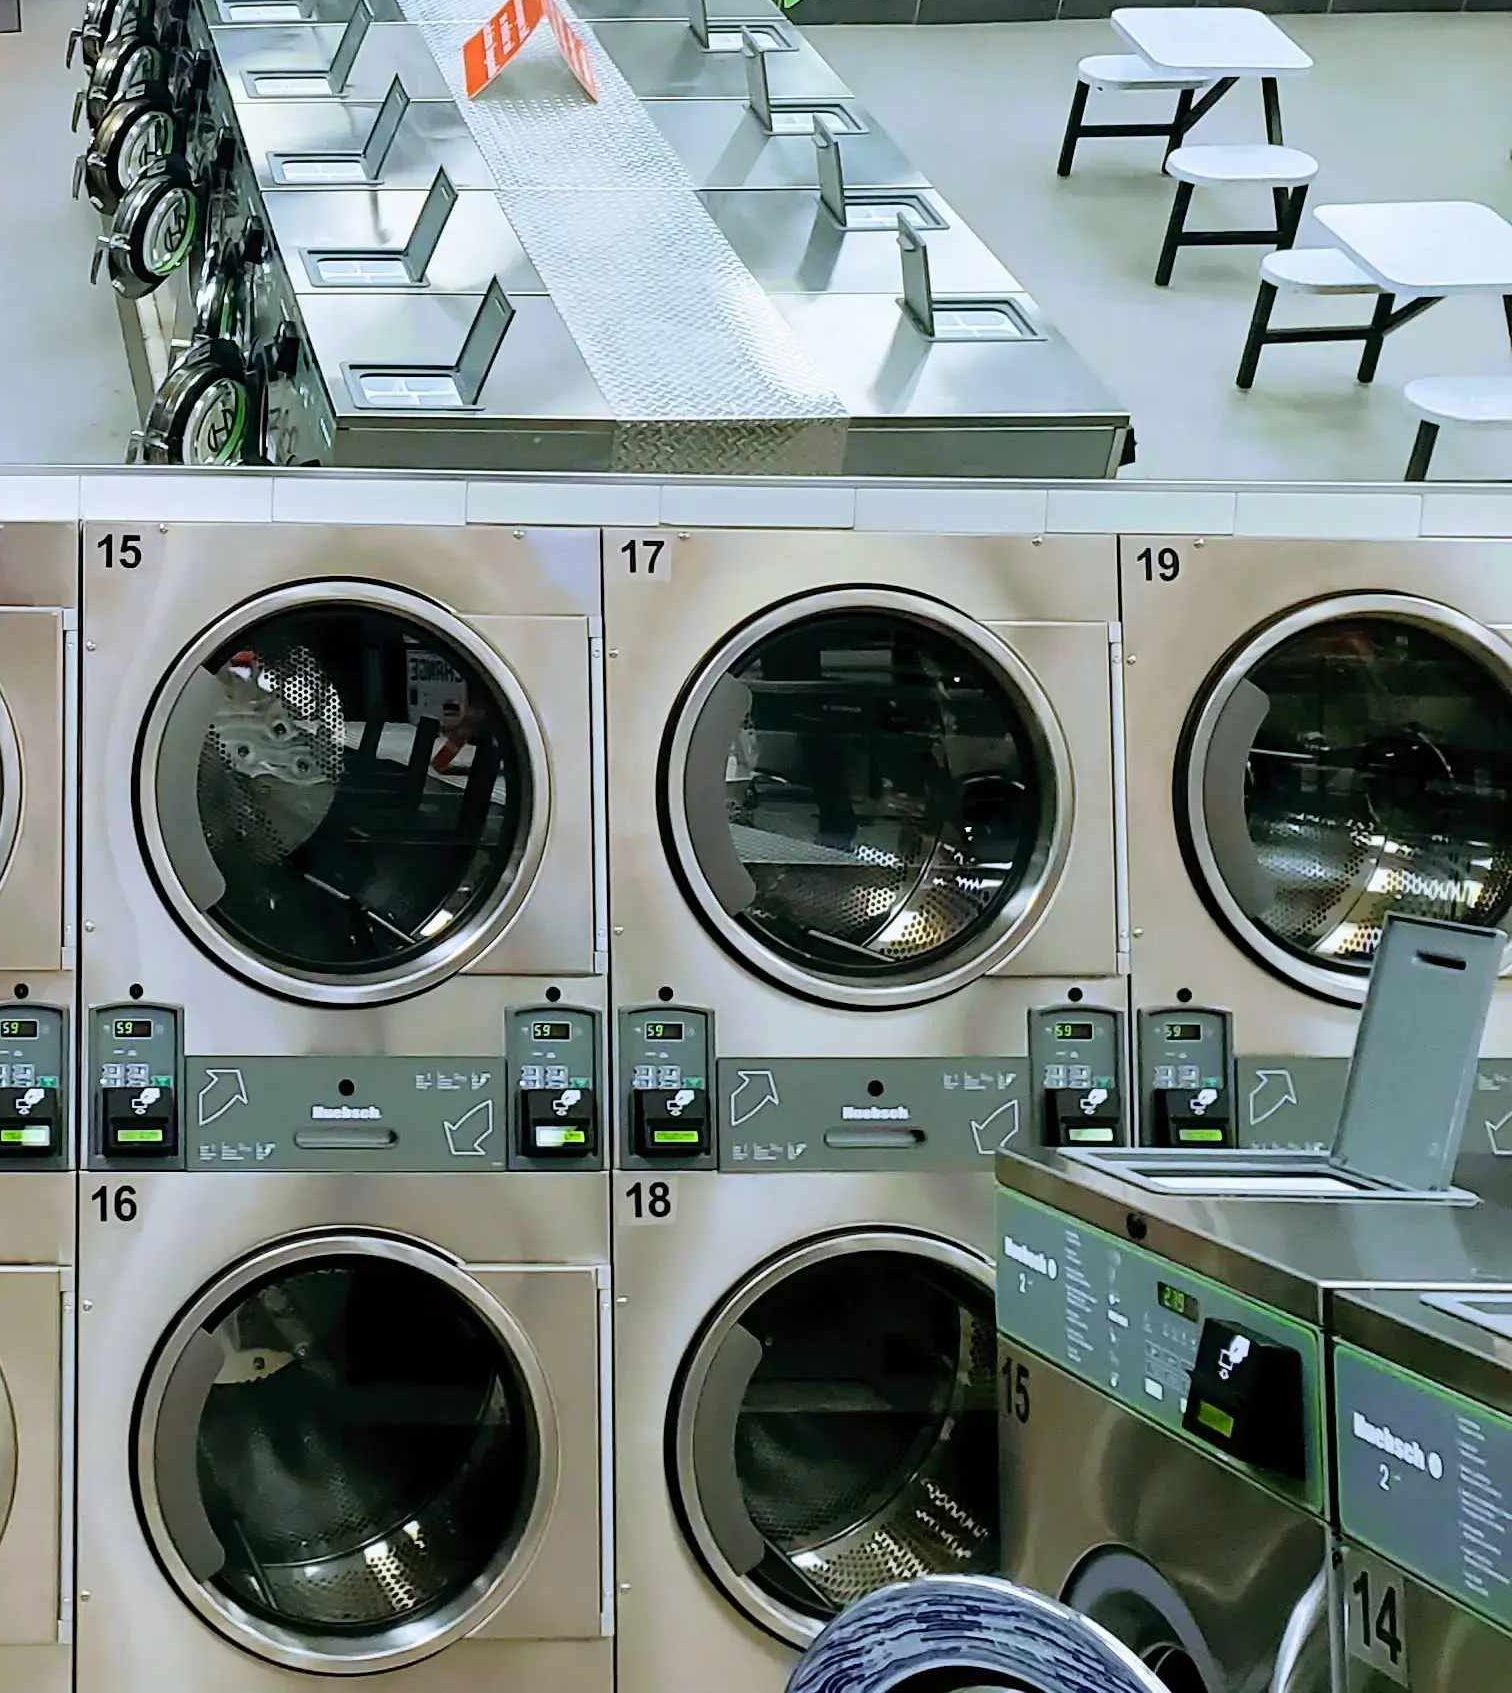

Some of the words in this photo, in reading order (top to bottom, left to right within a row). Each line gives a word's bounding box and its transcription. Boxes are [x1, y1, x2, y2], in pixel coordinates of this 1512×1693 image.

[97, 533, 142, 569] 15
[621, 539, 665, 574] 17
[1137, 547, 1180, 582] 19
[91, 1185, 137, 1222] 16
[626, 1181, 671, 1218] 18
[1001, 1354, 1031, 1425] 15
[1352, 1570, 1403, 1666] 14
